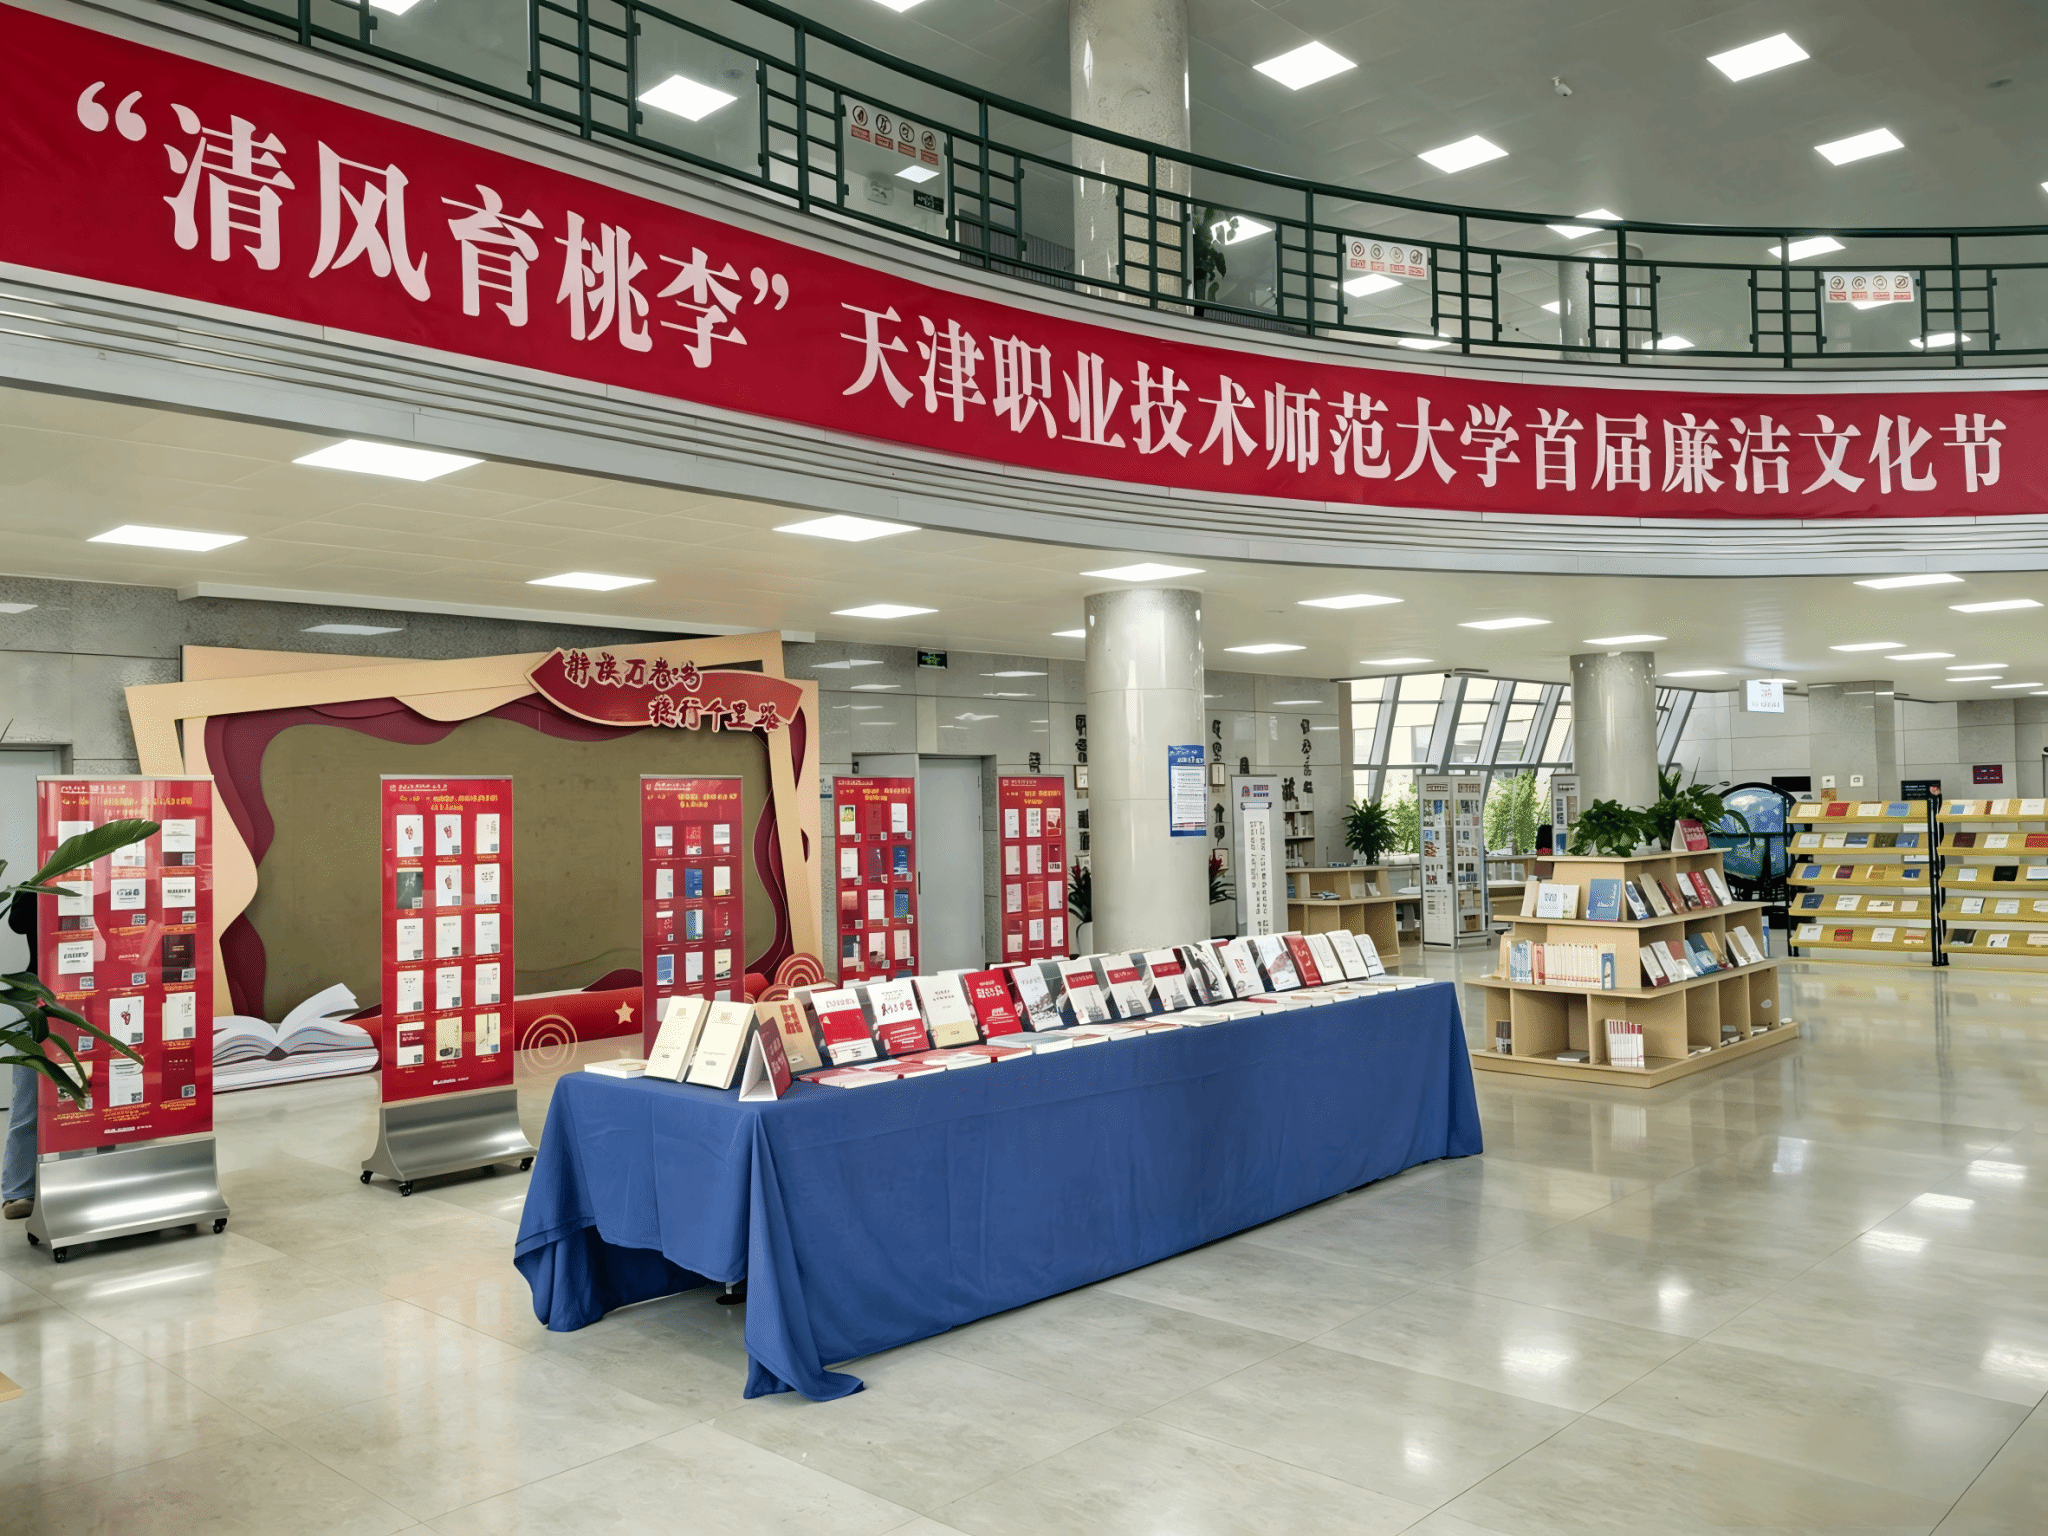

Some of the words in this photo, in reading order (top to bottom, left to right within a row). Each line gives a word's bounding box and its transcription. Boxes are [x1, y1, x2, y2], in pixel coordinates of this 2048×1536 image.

[77, 81, 790, 369] “清风育桃李”
[840, 302, 2007, 496] 天津职业技术师范大学首届廉洁文化节
